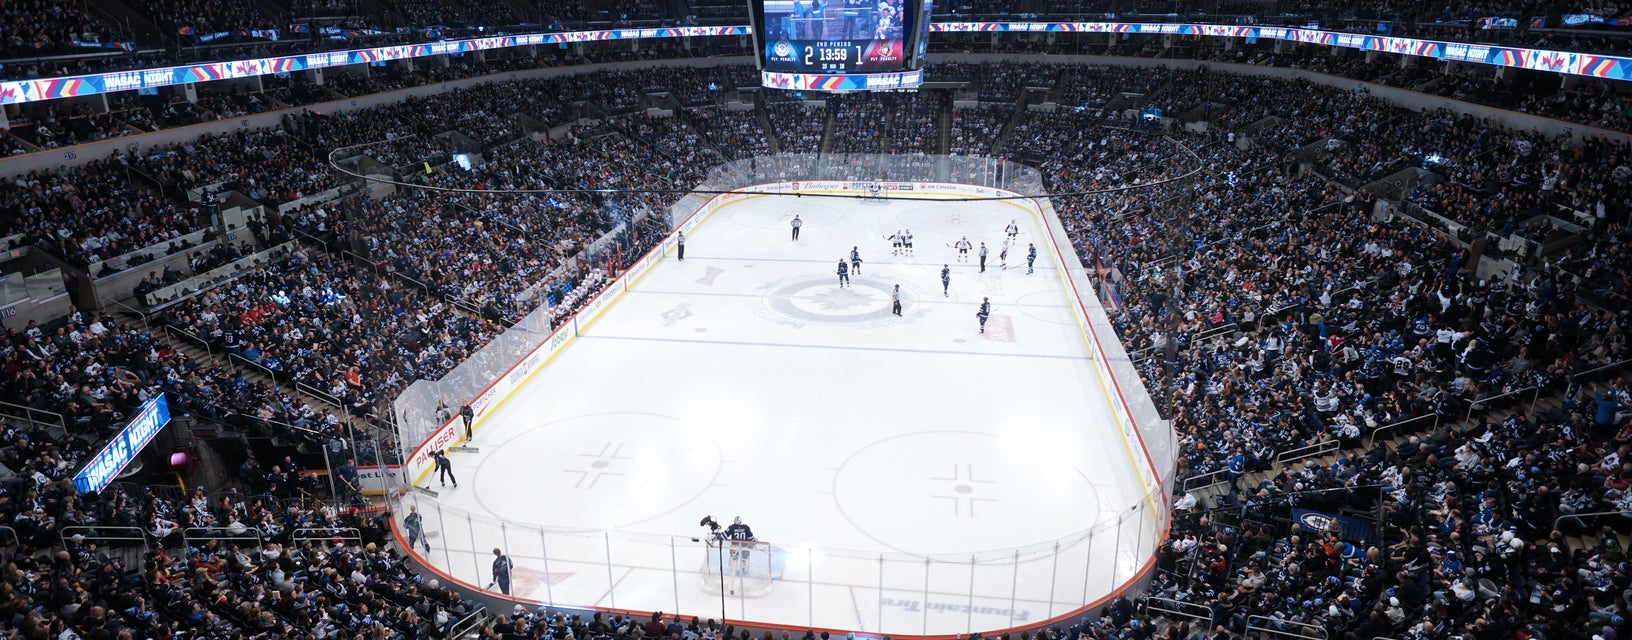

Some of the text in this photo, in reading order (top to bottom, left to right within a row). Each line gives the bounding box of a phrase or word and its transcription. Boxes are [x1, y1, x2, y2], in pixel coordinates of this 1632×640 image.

[804, 45, 814, 65] 2
[820, 48, 847, 61] 13:59
[855, 45, 864, 65] 1
[1445, 45, 1490, 60] WASAC NIGHT
[103, 70, 174, 89] WASAC NIGHT
[866, 74, 920, 87] WASAC NIGHT
[1395, 359, 1410, 370] 29
[86, 407, 159, 491] WASAC NIGHT
[416, 426, 456, 470] PALLISER
[881, 598, 1030, 621] Fountain Tire
